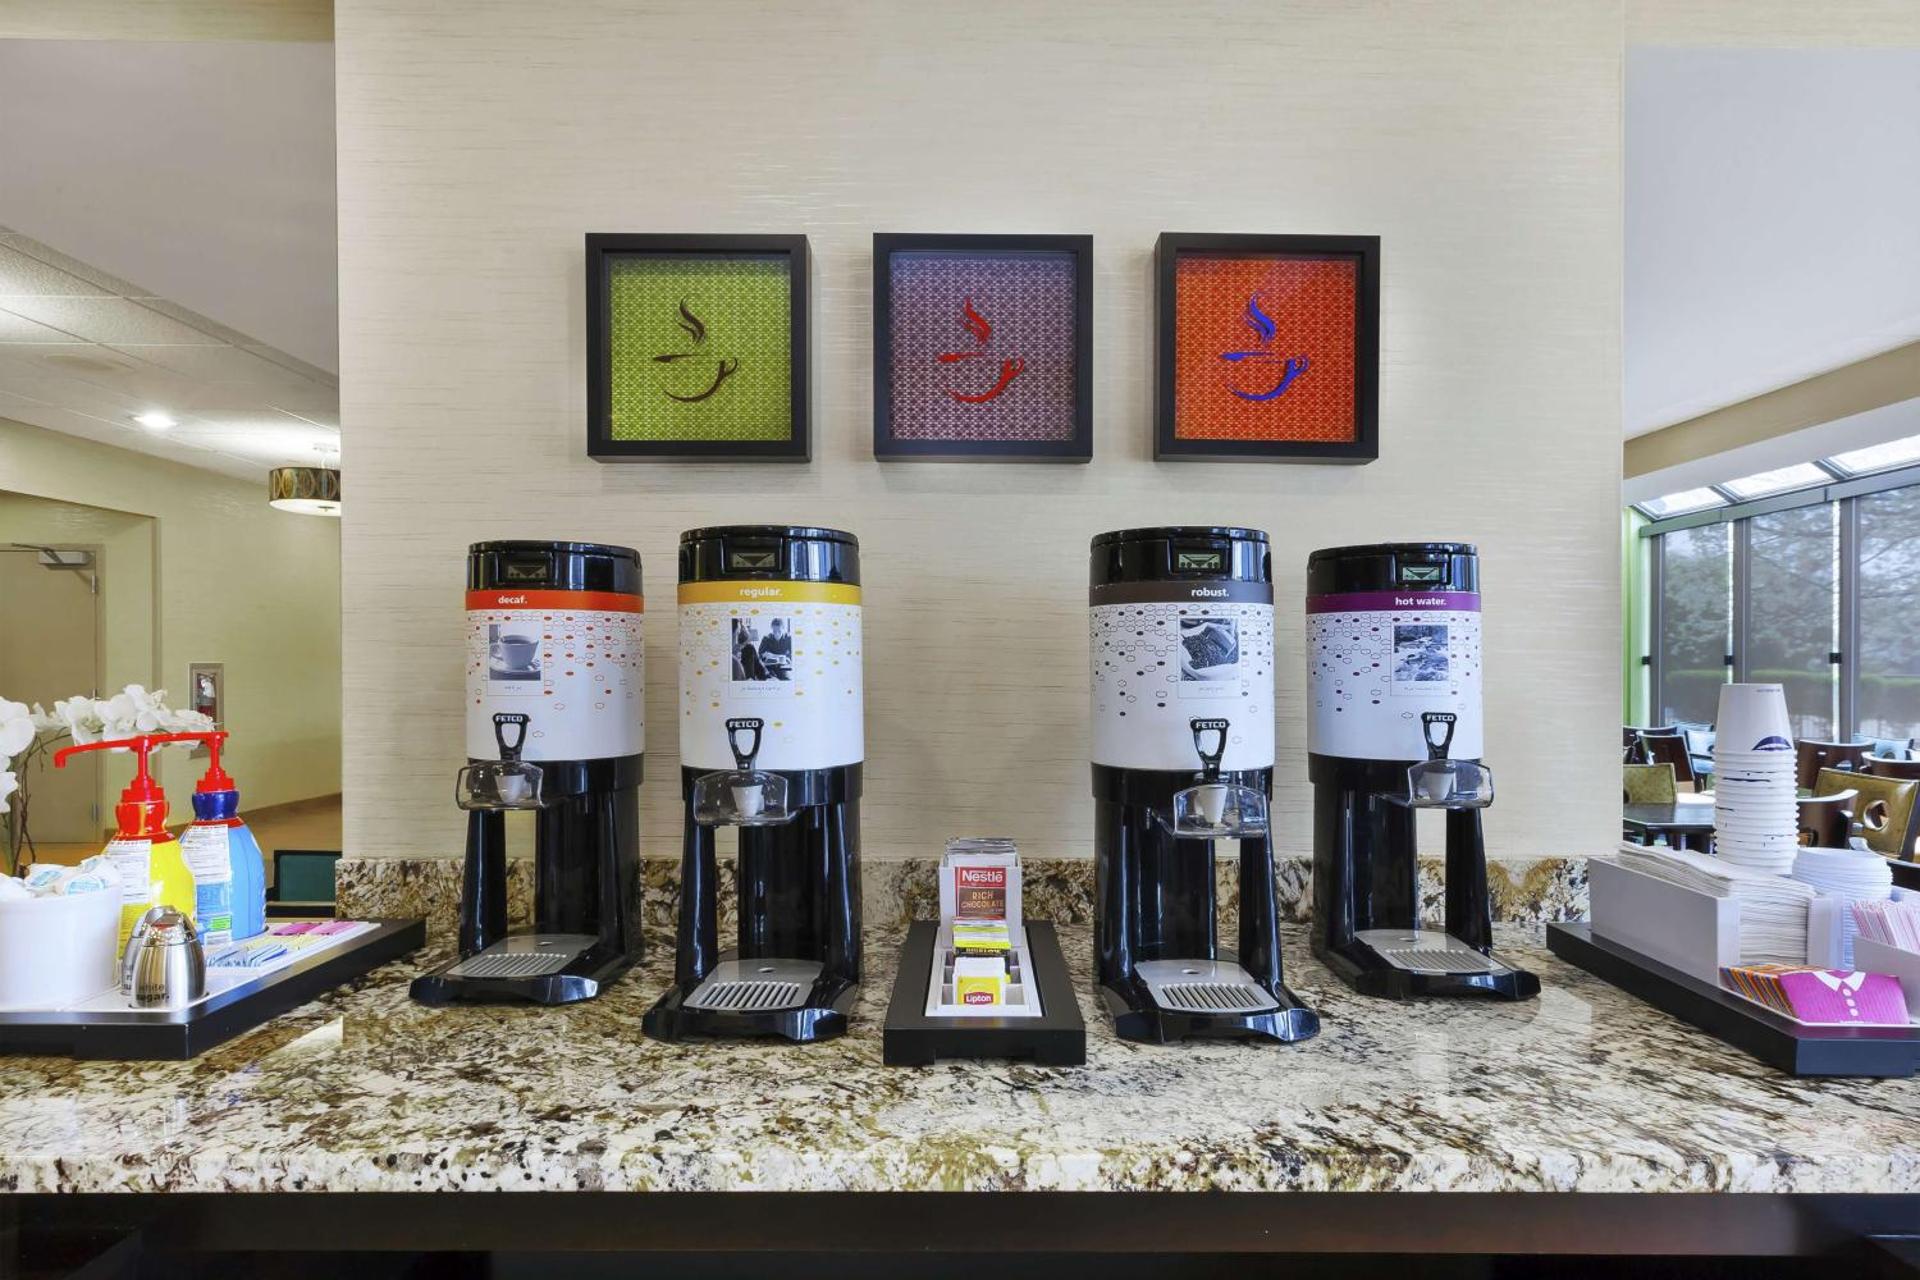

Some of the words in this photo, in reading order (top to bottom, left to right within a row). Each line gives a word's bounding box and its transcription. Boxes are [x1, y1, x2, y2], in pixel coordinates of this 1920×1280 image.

[740, 586, 783, 598] regular.
[1191, 587, 1230, 598] robust.
[498, 594, 528, 605] decaf.
[1395, 597, 1414, 606] hot
[1416, 598, 1447, 606] water.
[1195, 721, 1226, 729] FETCO
[972, 890, 994, 900] RICH
[966, 995, 993, 1004] Lipton
